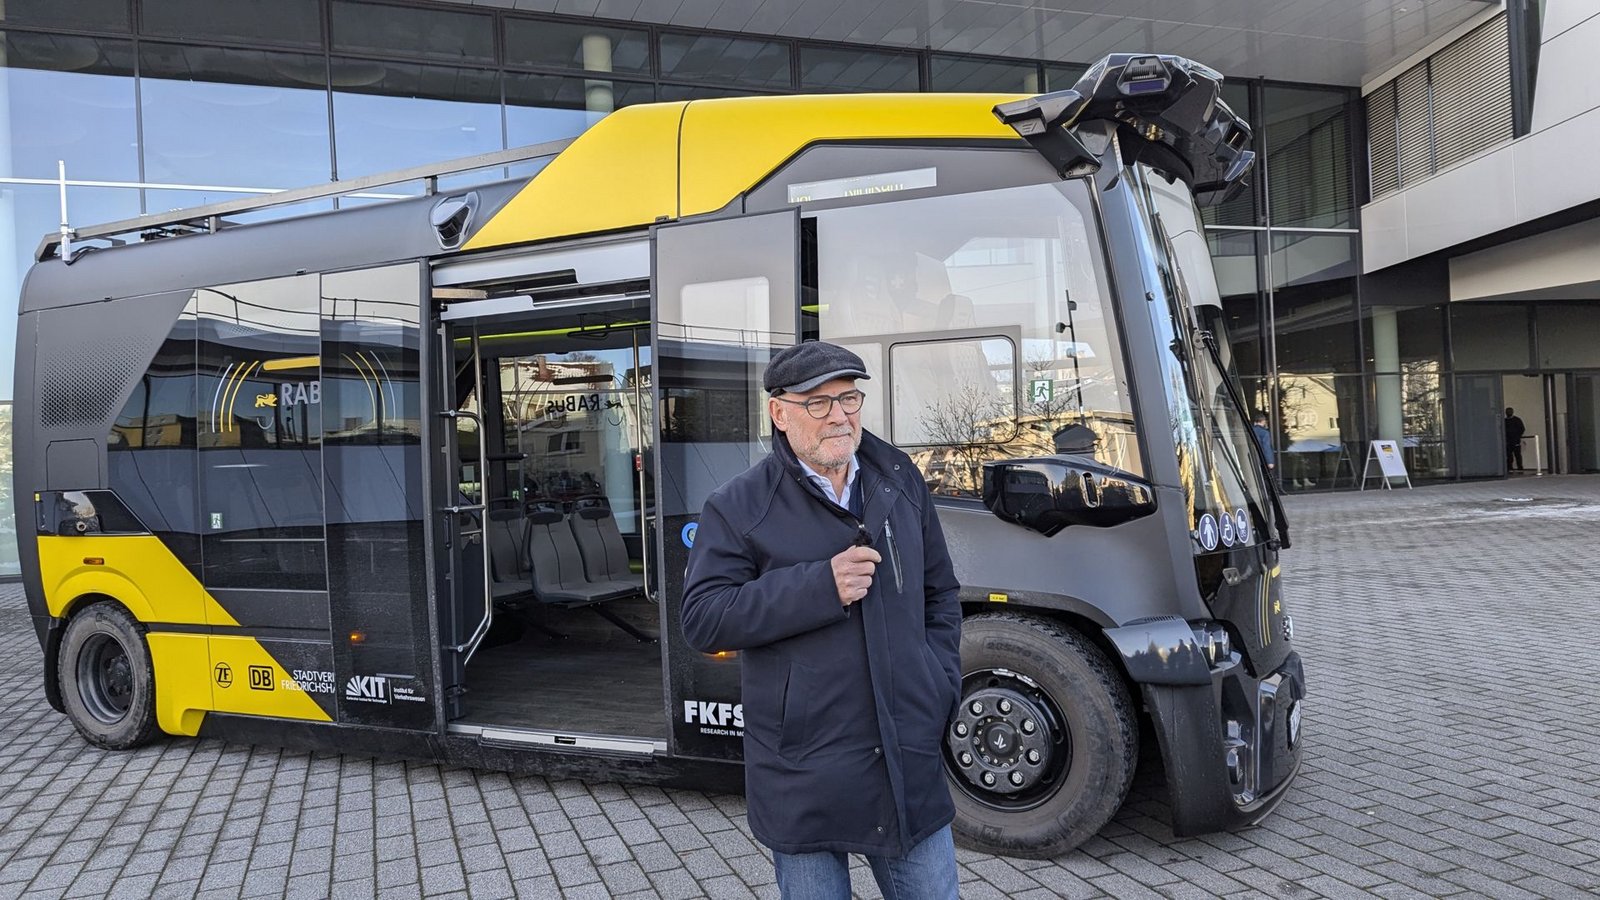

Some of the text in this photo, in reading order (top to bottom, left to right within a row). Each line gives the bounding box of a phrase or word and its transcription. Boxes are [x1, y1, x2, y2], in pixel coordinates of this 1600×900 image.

[214, 667, 232, 683] ZF
[252, 669, 271, 687] DB
[360, 676, 385, 698] KIT
[684, 701, 744, 727] FKFS
